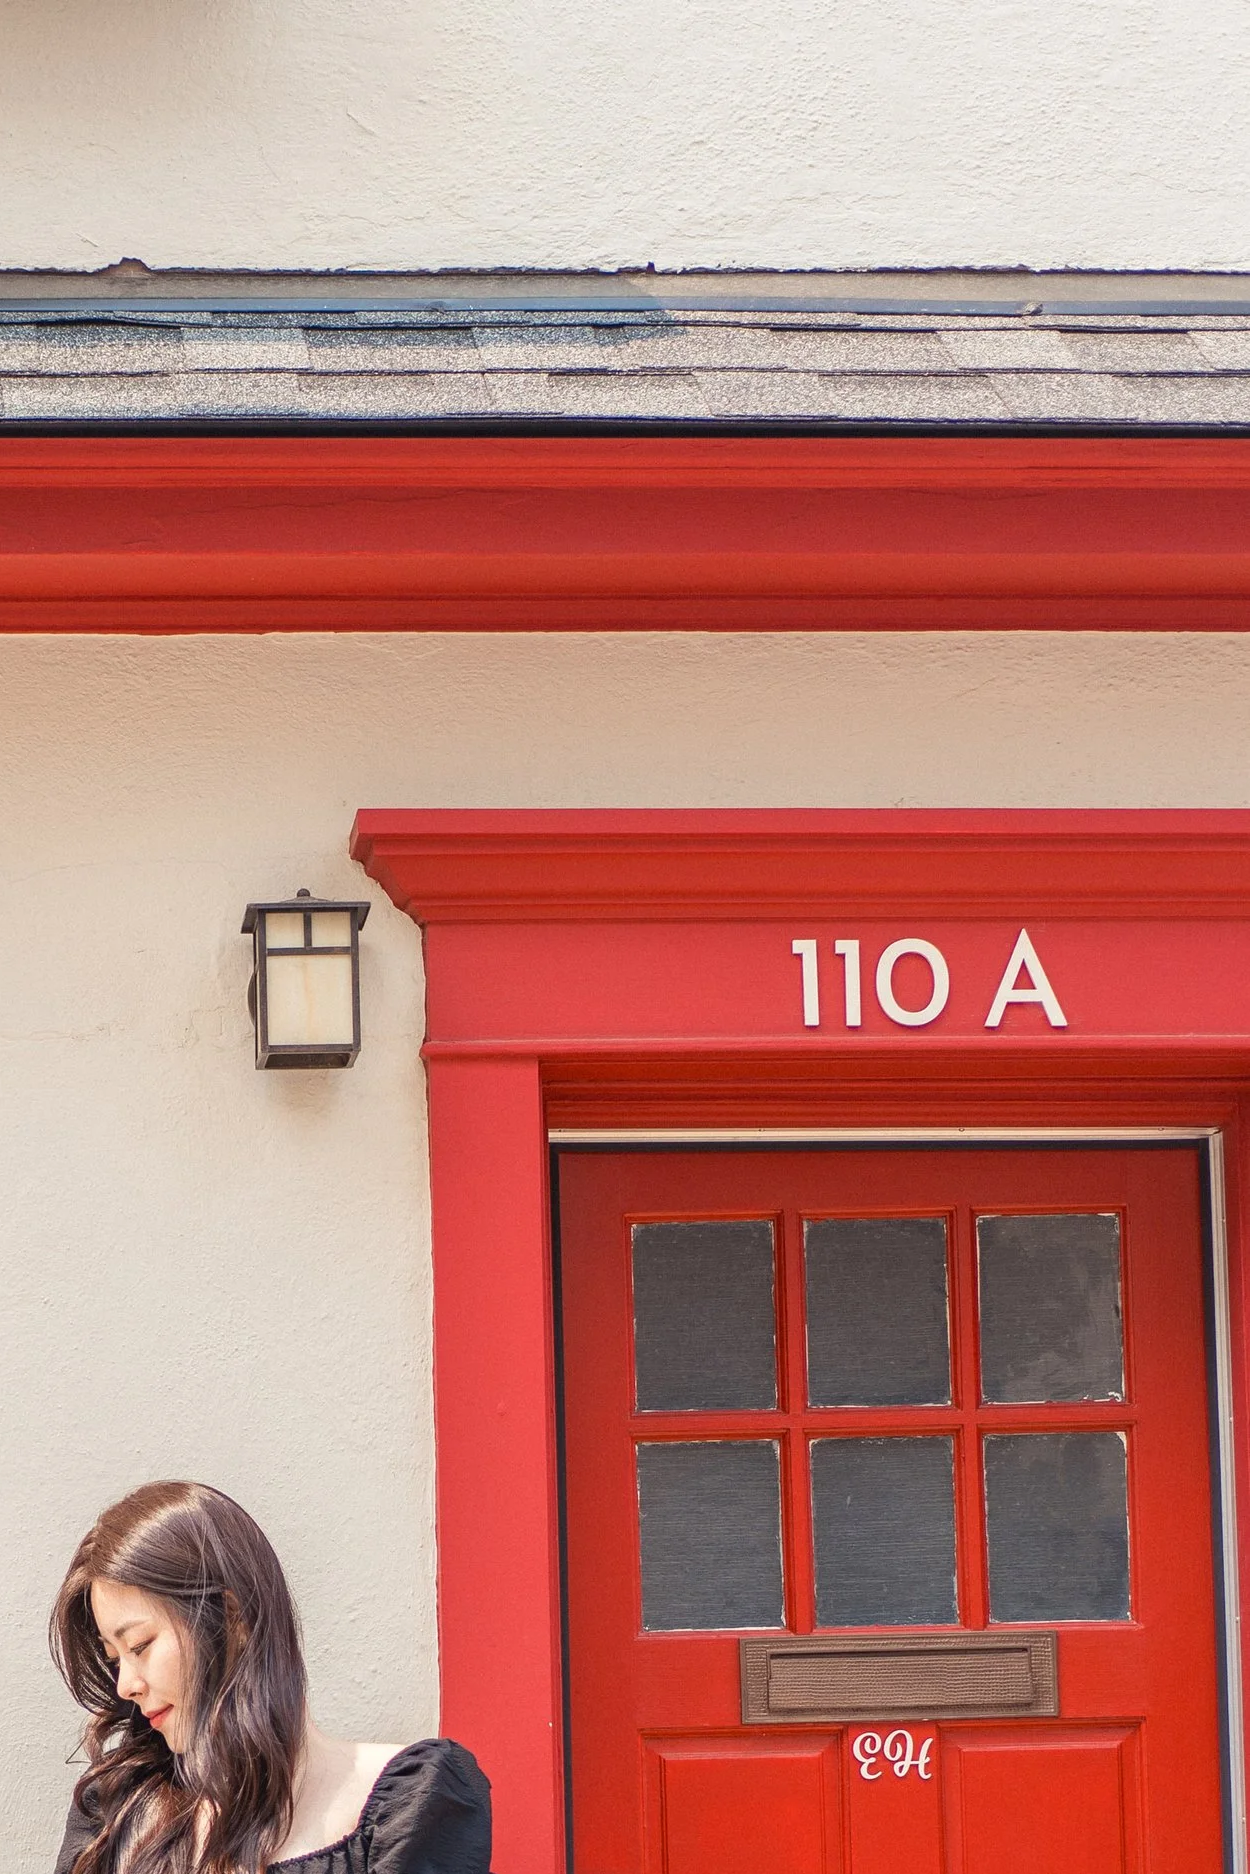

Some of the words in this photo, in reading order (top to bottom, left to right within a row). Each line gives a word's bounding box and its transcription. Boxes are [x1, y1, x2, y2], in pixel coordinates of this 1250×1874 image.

[791, 937, 951, 1027] 110
[983, 926, 1069, 1028] A
[852, 1729, 934, 1780] EH
